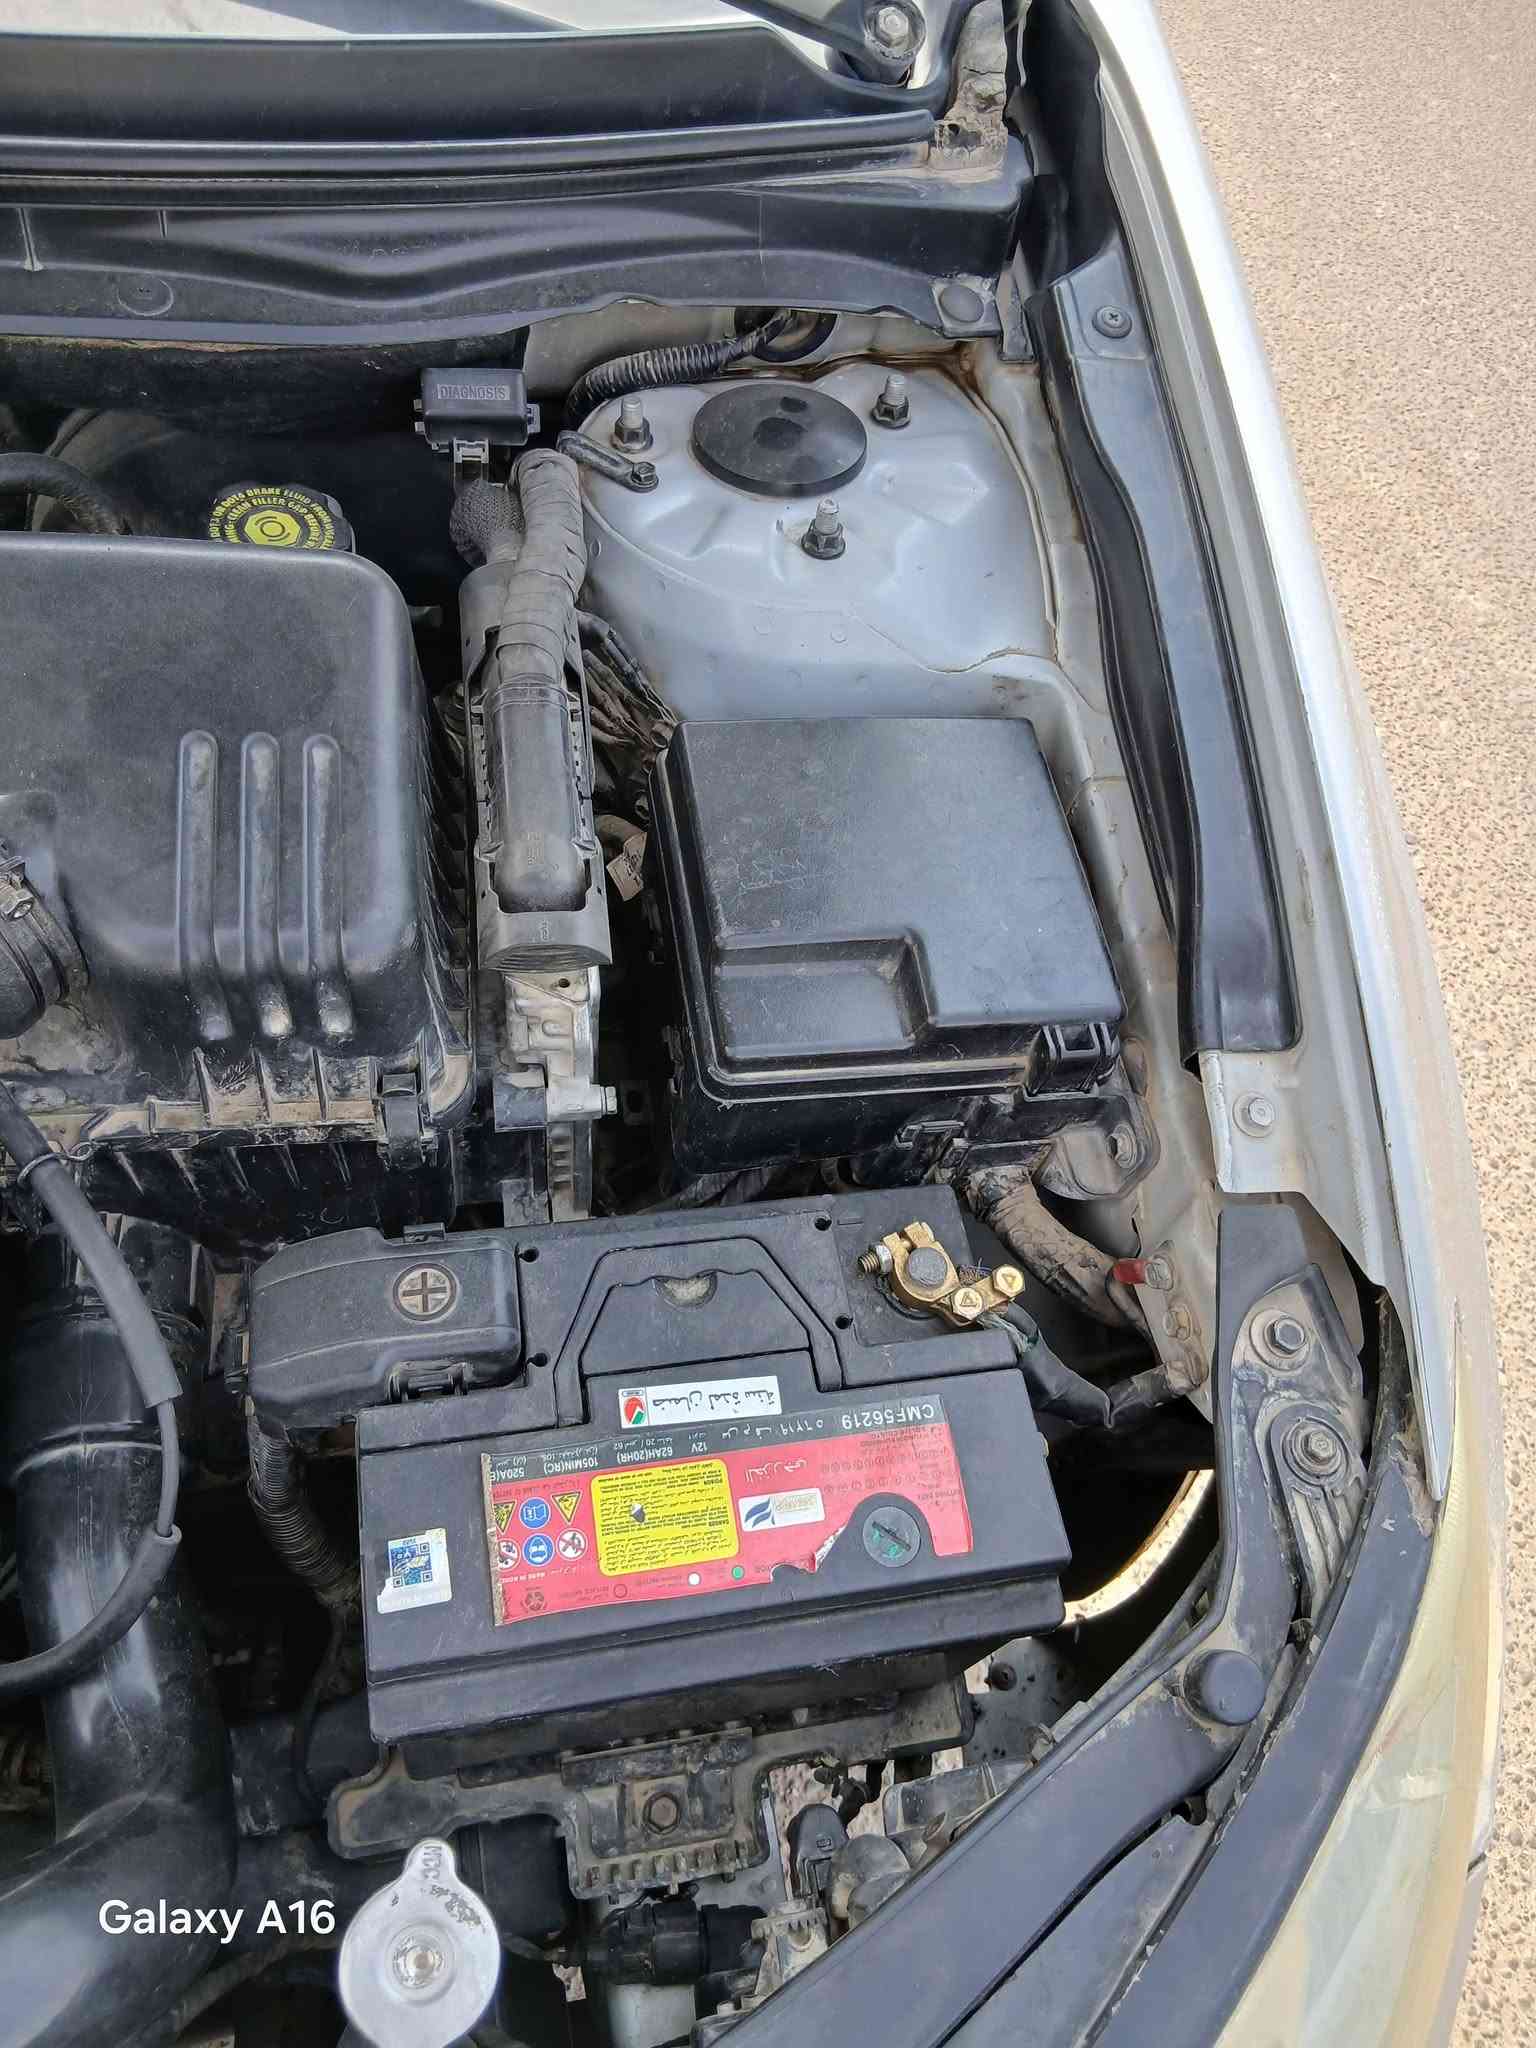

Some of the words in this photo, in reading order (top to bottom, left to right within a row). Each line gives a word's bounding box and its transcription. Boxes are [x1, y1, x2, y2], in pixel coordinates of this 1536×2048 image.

[440, 384, 507, 400] DIAGNOSIS
[246, 487, 281, 497] BRAKE
[283, 489, 311, 504] FLUID
[252, 497, 285, 506] FILLER
[288, 501, 308, 514] CAP
[652, 1390, 703, 1412] ضمان
[708, 1392, 739, 1410] لمدة
[745, 1390, 775, 1405] سنة
[841, 1403, 934, 1430] CMF56219
[616, 1446, 673, 1463] 62AH(20HR)
[691, 1442, 707, 1453] 12V
[543, 1456, 599, 1474] 105MIN(RC)
